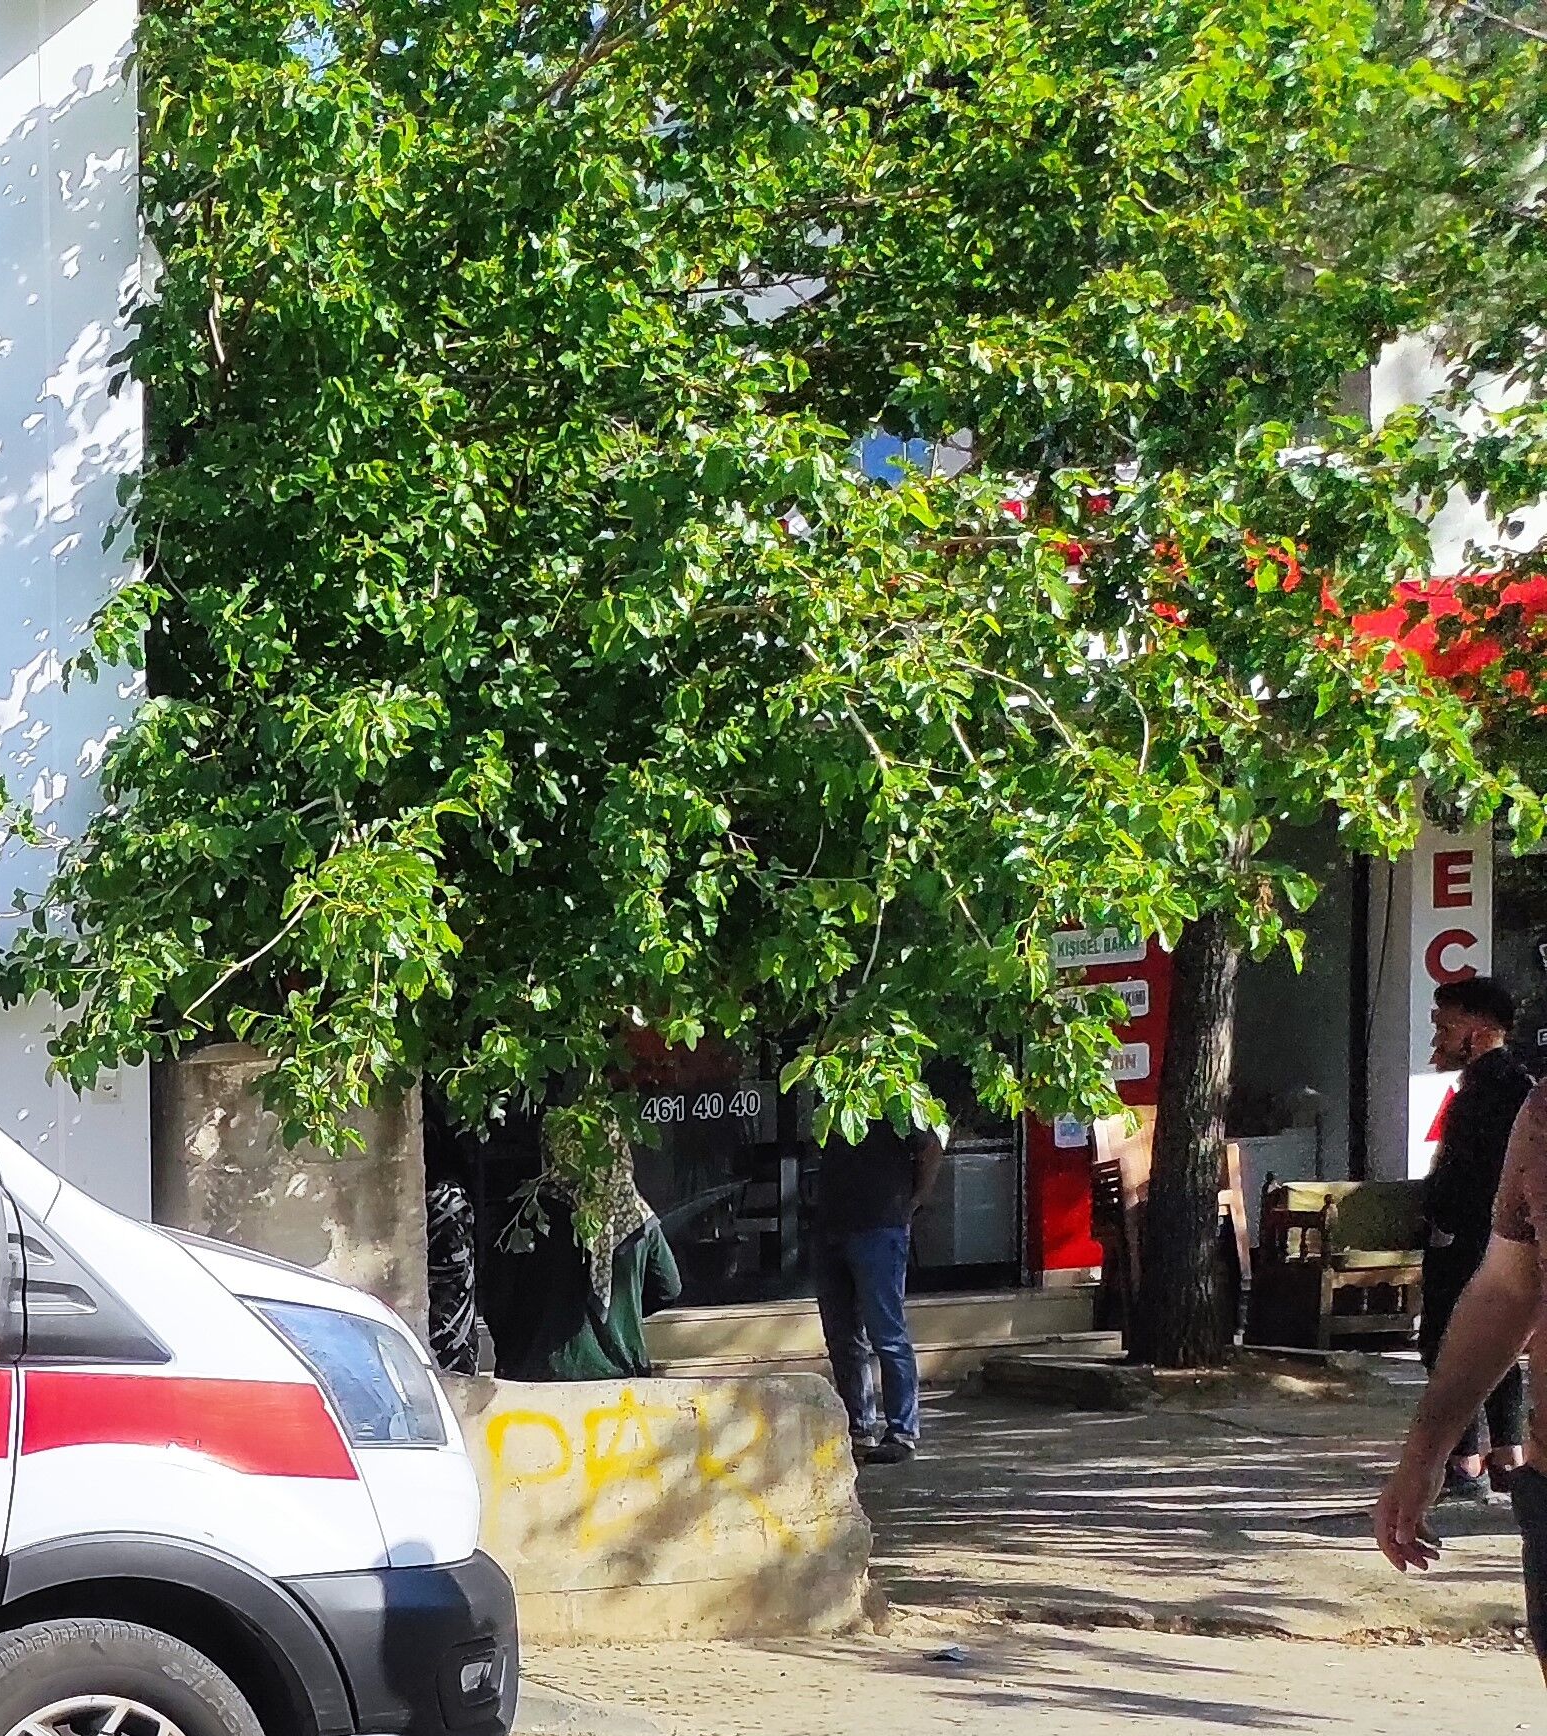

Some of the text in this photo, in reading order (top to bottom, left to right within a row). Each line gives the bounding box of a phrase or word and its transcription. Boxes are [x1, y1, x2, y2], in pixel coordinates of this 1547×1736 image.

[641, 1089, 760, 1123] 461 40 40
